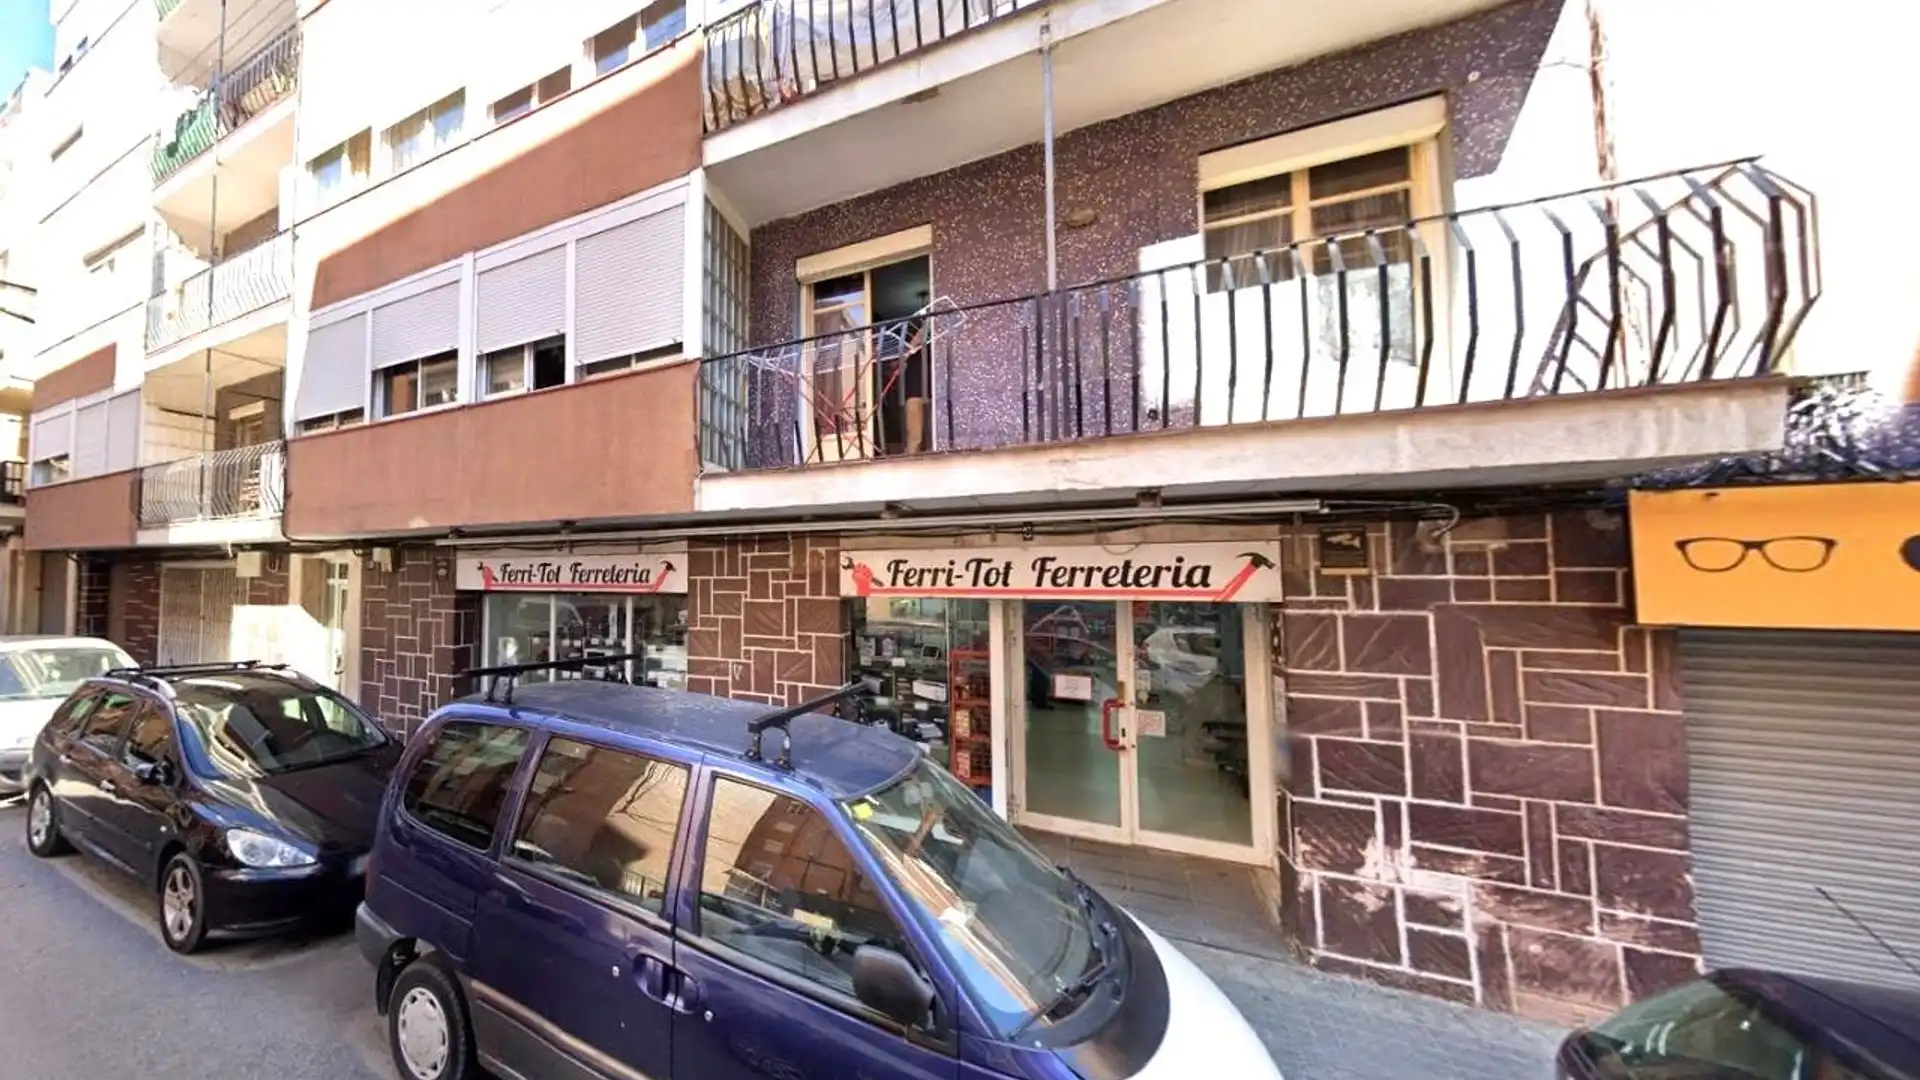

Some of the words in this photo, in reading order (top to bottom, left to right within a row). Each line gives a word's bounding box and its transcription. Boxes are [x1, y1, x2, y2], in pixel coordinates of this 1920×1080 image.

[500, 562, 561, 584] Ferri-Tot
[569, 562, 651, 584] Ferreteria
[886, 558, 1013, 587] Ferri-Tot
[1031, 556, 1211, 588] Ferreteria
